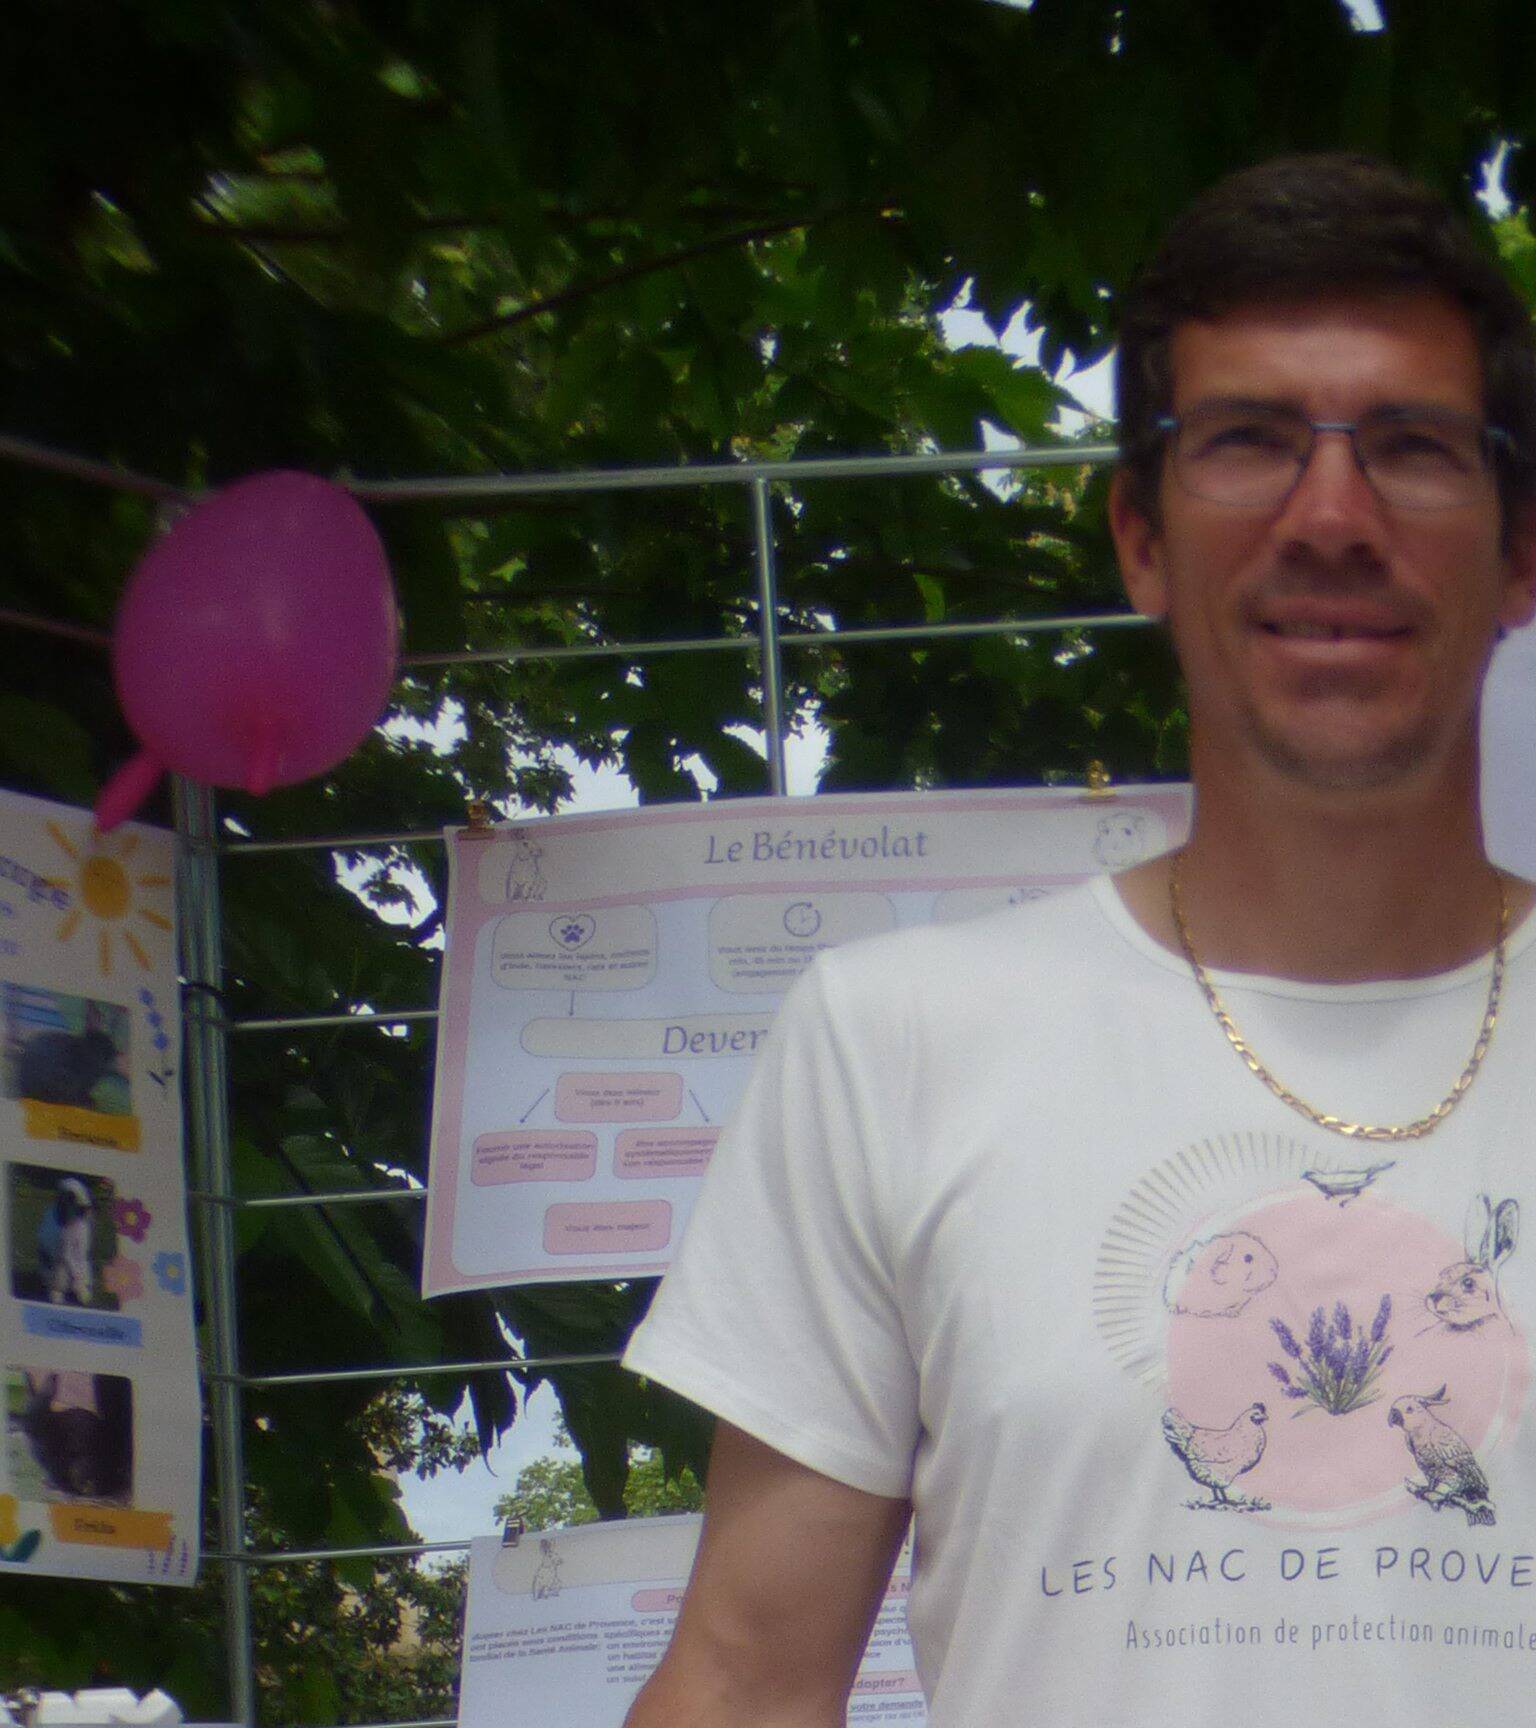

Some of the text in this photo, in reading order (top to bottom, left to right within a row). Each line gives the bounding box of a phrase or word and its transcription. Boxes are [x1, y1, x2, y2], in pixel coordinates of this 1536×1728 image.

[704, 824, 928, 865] Le Bénévolat
[1041, 1556, 1117, 1598] LES
[1148, 1547, 1248, 1585] NAC
[1280, 1546, 1342, 1582] DE
[1125, 1618, 1262, 1651] Association
[1275, 1618, 1300, 1645] de
[1311, 1616, 1434, 1651] protection
